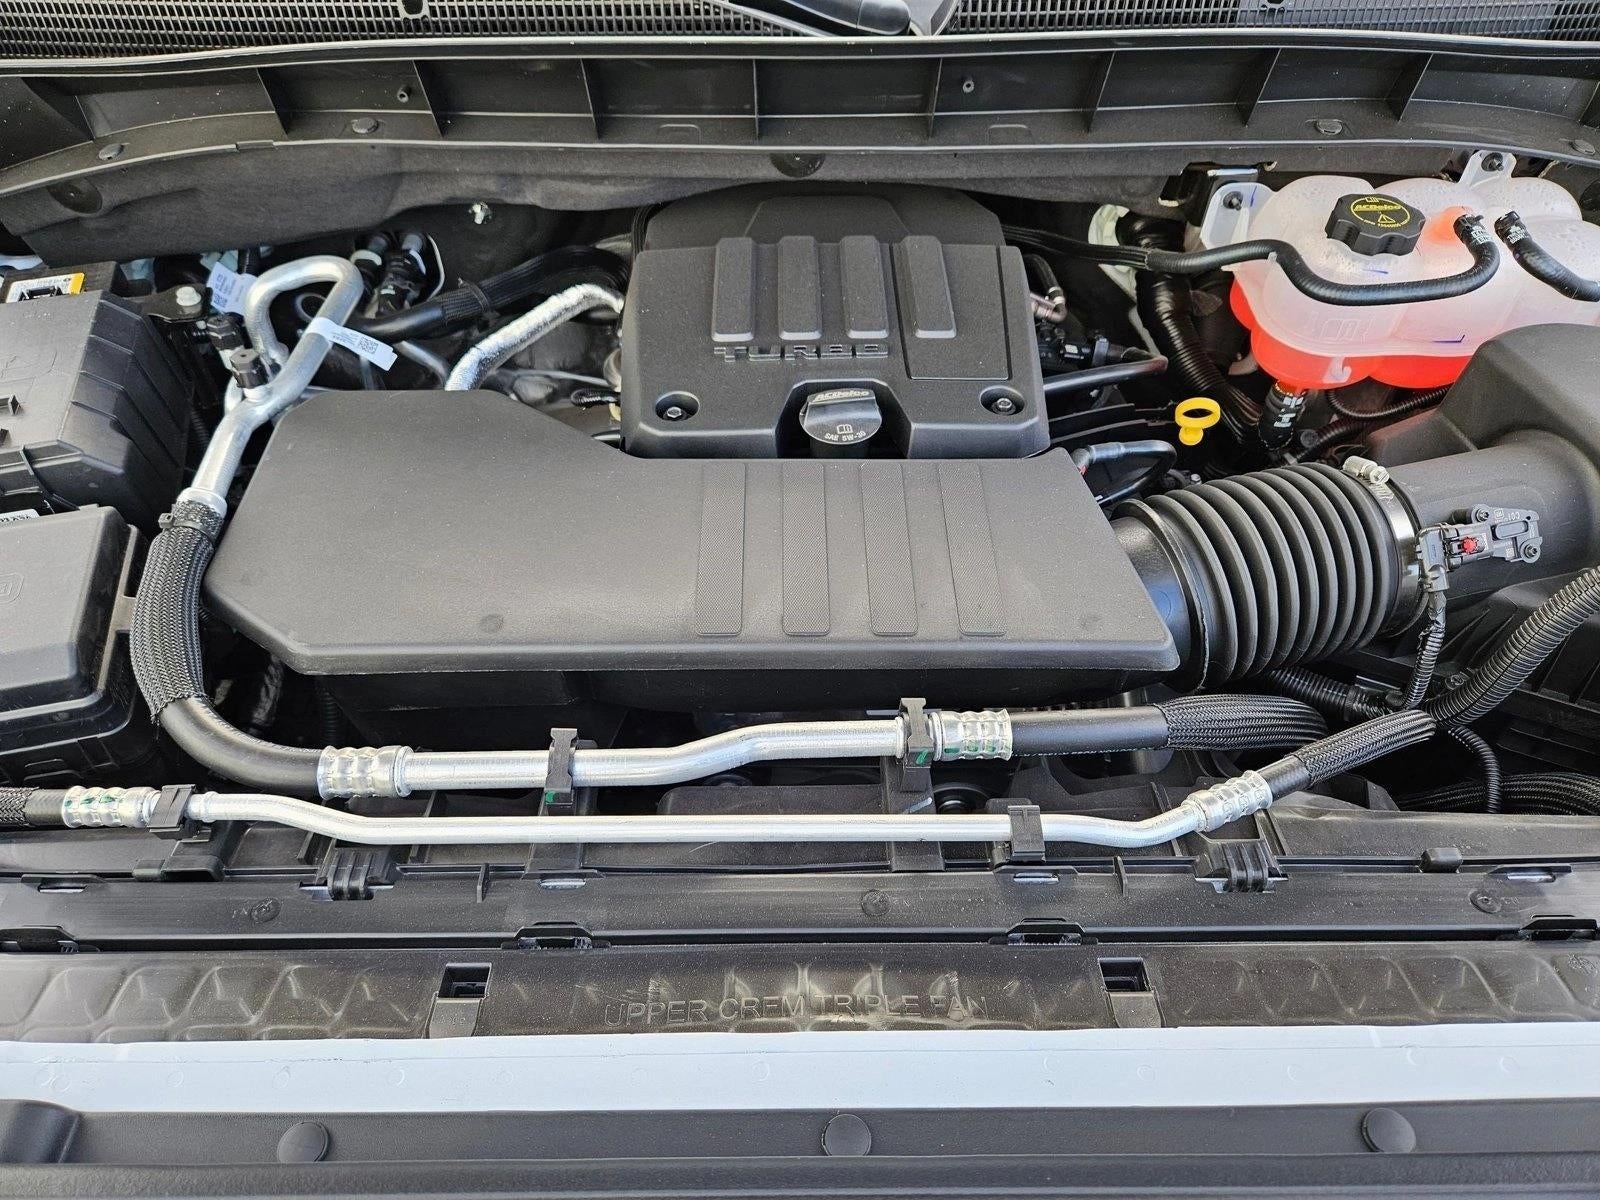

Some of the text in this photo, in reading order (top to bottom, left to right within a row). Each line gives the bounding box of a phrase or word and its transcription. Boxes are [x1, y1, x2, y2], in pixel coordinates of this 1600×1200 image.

[713, 344, 889, 362] TURBO
[604, 1000, 710, 1026] UPPER
[814, 994, 921, 1019] TRIPLE
[929, 995, 989, 1021] FAN
